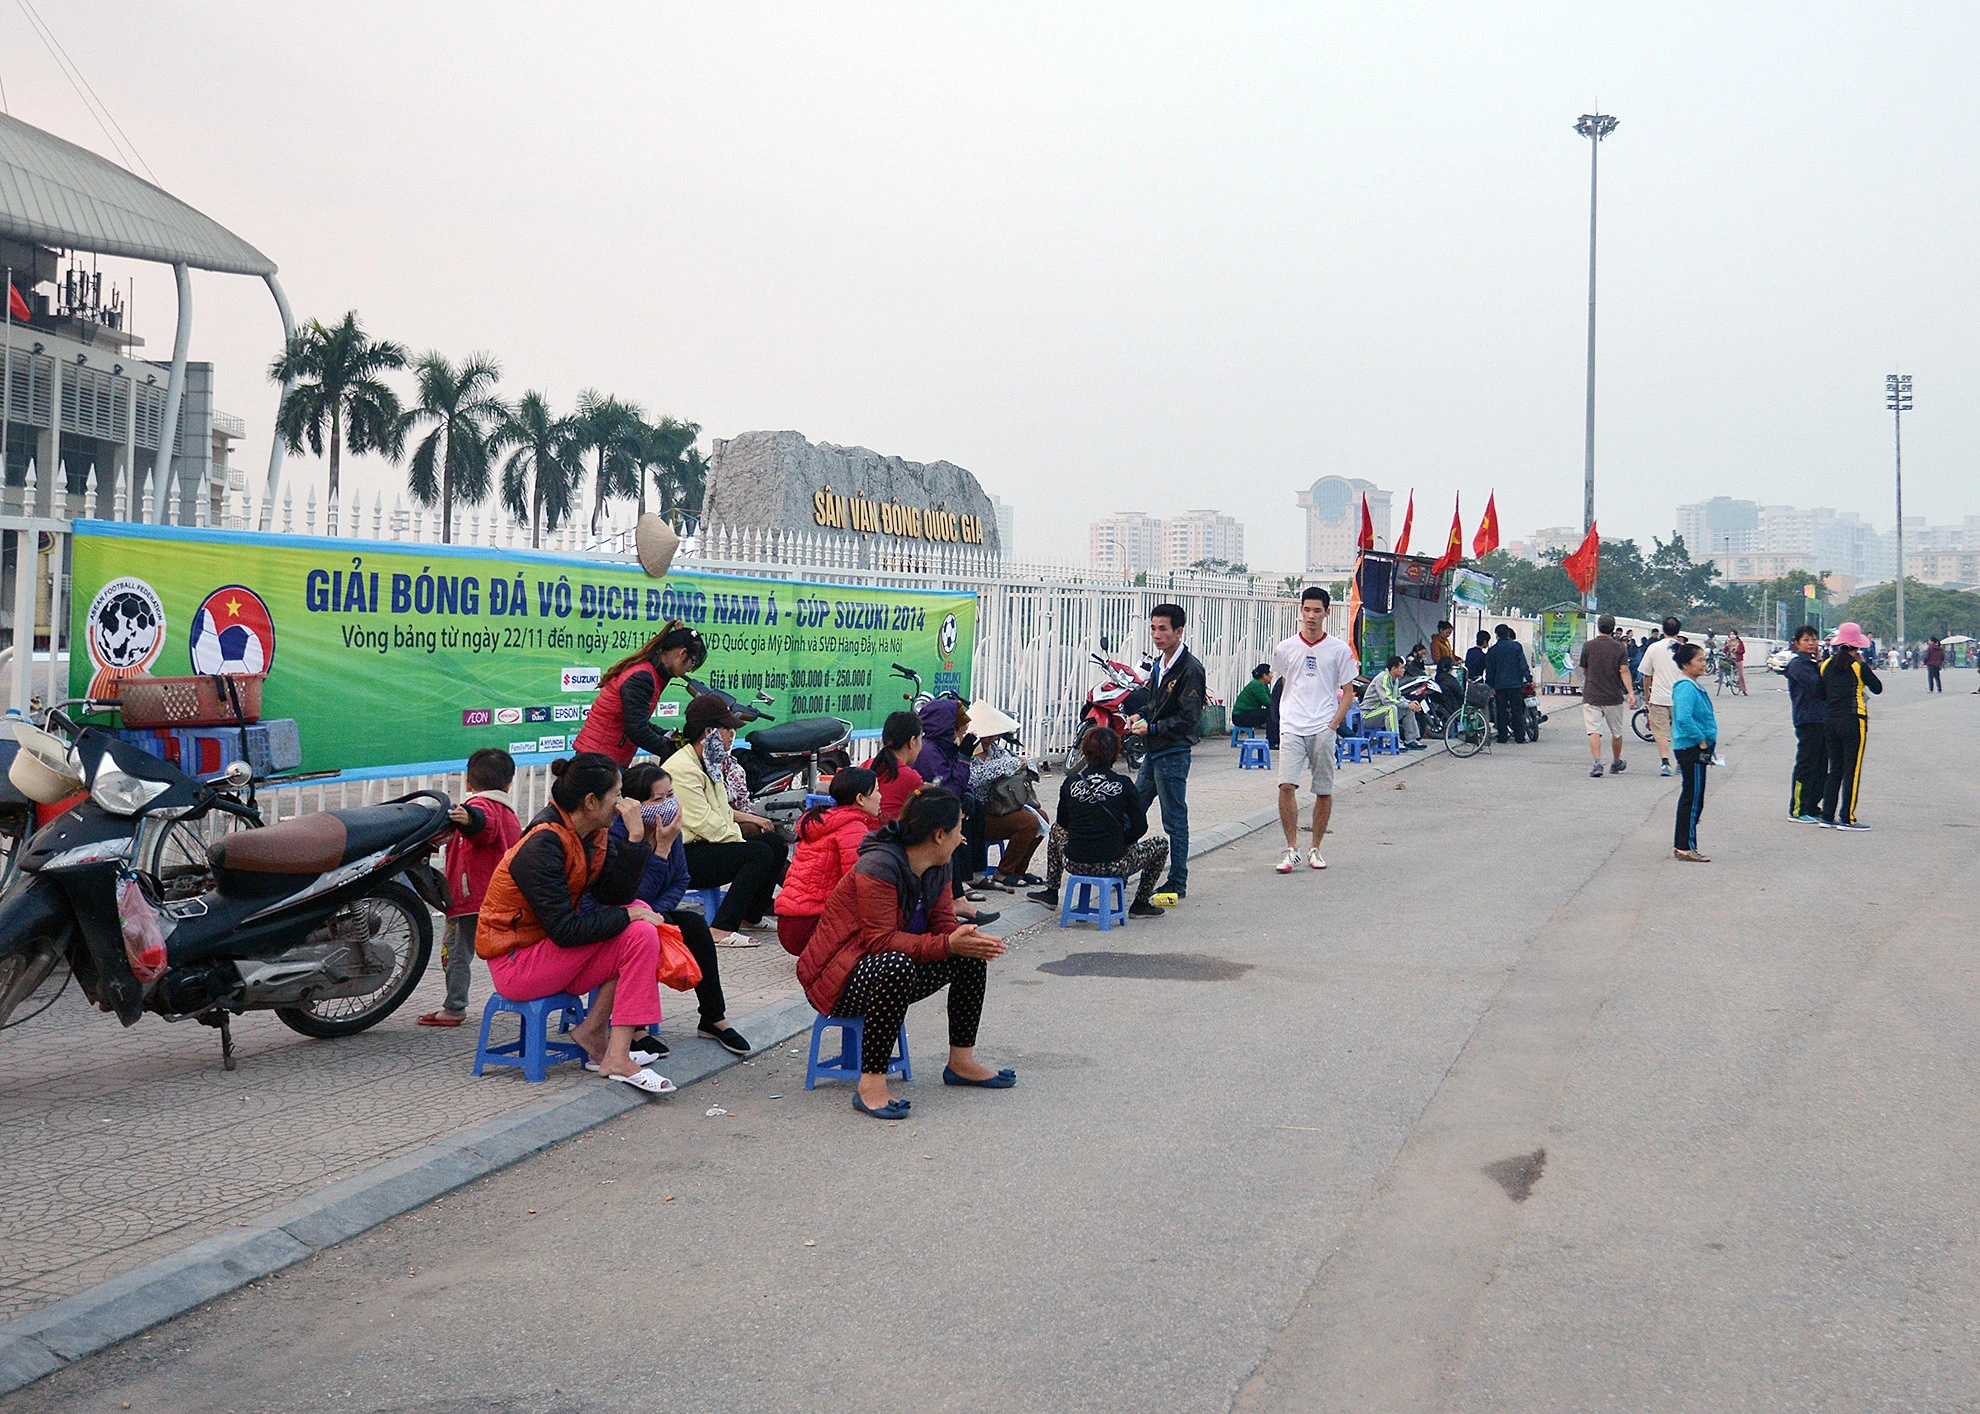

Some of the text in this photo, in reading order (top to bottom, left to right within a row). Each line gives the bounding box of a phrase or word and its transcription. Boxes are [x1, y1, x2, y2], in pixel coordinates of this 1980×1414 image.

[814, 485, 984, 544] SÂN VẬN ĐỘNG QUỐC GIA
[90, 582, 163, 620] ASEAN FOOTBALL FEDERATION
[306, 557, 379, 612] GIẢI
[392, 566, 480, 616] BÓNG
[490, 572, 528, 616] ĐÁ
[538, 575, 572, 618] VÔ
[580, 584, 638, 627] ĐỊCH
[646, 583, 707, 624] ĐÔNG
[713, 594, 760, 625] NAM
[765, 590, 778, 626] Á
[796, 594, 830, 628] CÚP
[834, 601, 890, 630] SUZUKI
[892, 605, 926, 632] 2014
[342, 624, 388, 654] Vòng
[394, 624, 436, 654] bảng
[442, 626, 460, 648] từ
[462, 626, 500, 654] ngày
[503, 627, 542, 649] 22/11
[548, 626, 573, 649] đến
[577, 630, 608, 654] ngày
[723, 632, 748, 652] Quốc
[751, 634, 766, 656] gia
[768, 634, 782, 656] Mỹ
[784, 634, 806, 652] Đình
[808, 635, 818, 652] và
[819, 636, 836, 652] SVĐ
[838, 636, 860, 656] Hàng
[879, 638, 888, 652] Hà
[890, 638, 902, 656] Nội
[572, 676, 599, 684] SUZUKI
[710, 670, 726, 690] Giá
[728, 669, 738, 690] vé
[742, 669, 762, 691] vòng
[765, 667, 788, 690] bảng:
[790, 670, 822, 688] 300.000
[824, 670, 830, 688] đ
[836, 669, 866, 687] 250.000
[866, 669, 872, 686] đ
[934, 672, 960, 684] SUZUKI
[556, 708, 579, 719] EPSON
[792, 695, 824, 714] 200.000
[825, 695, 830, 712] đ
[838, 694, 866, 712] 100.000
[867, 694, 872, 710] đ
